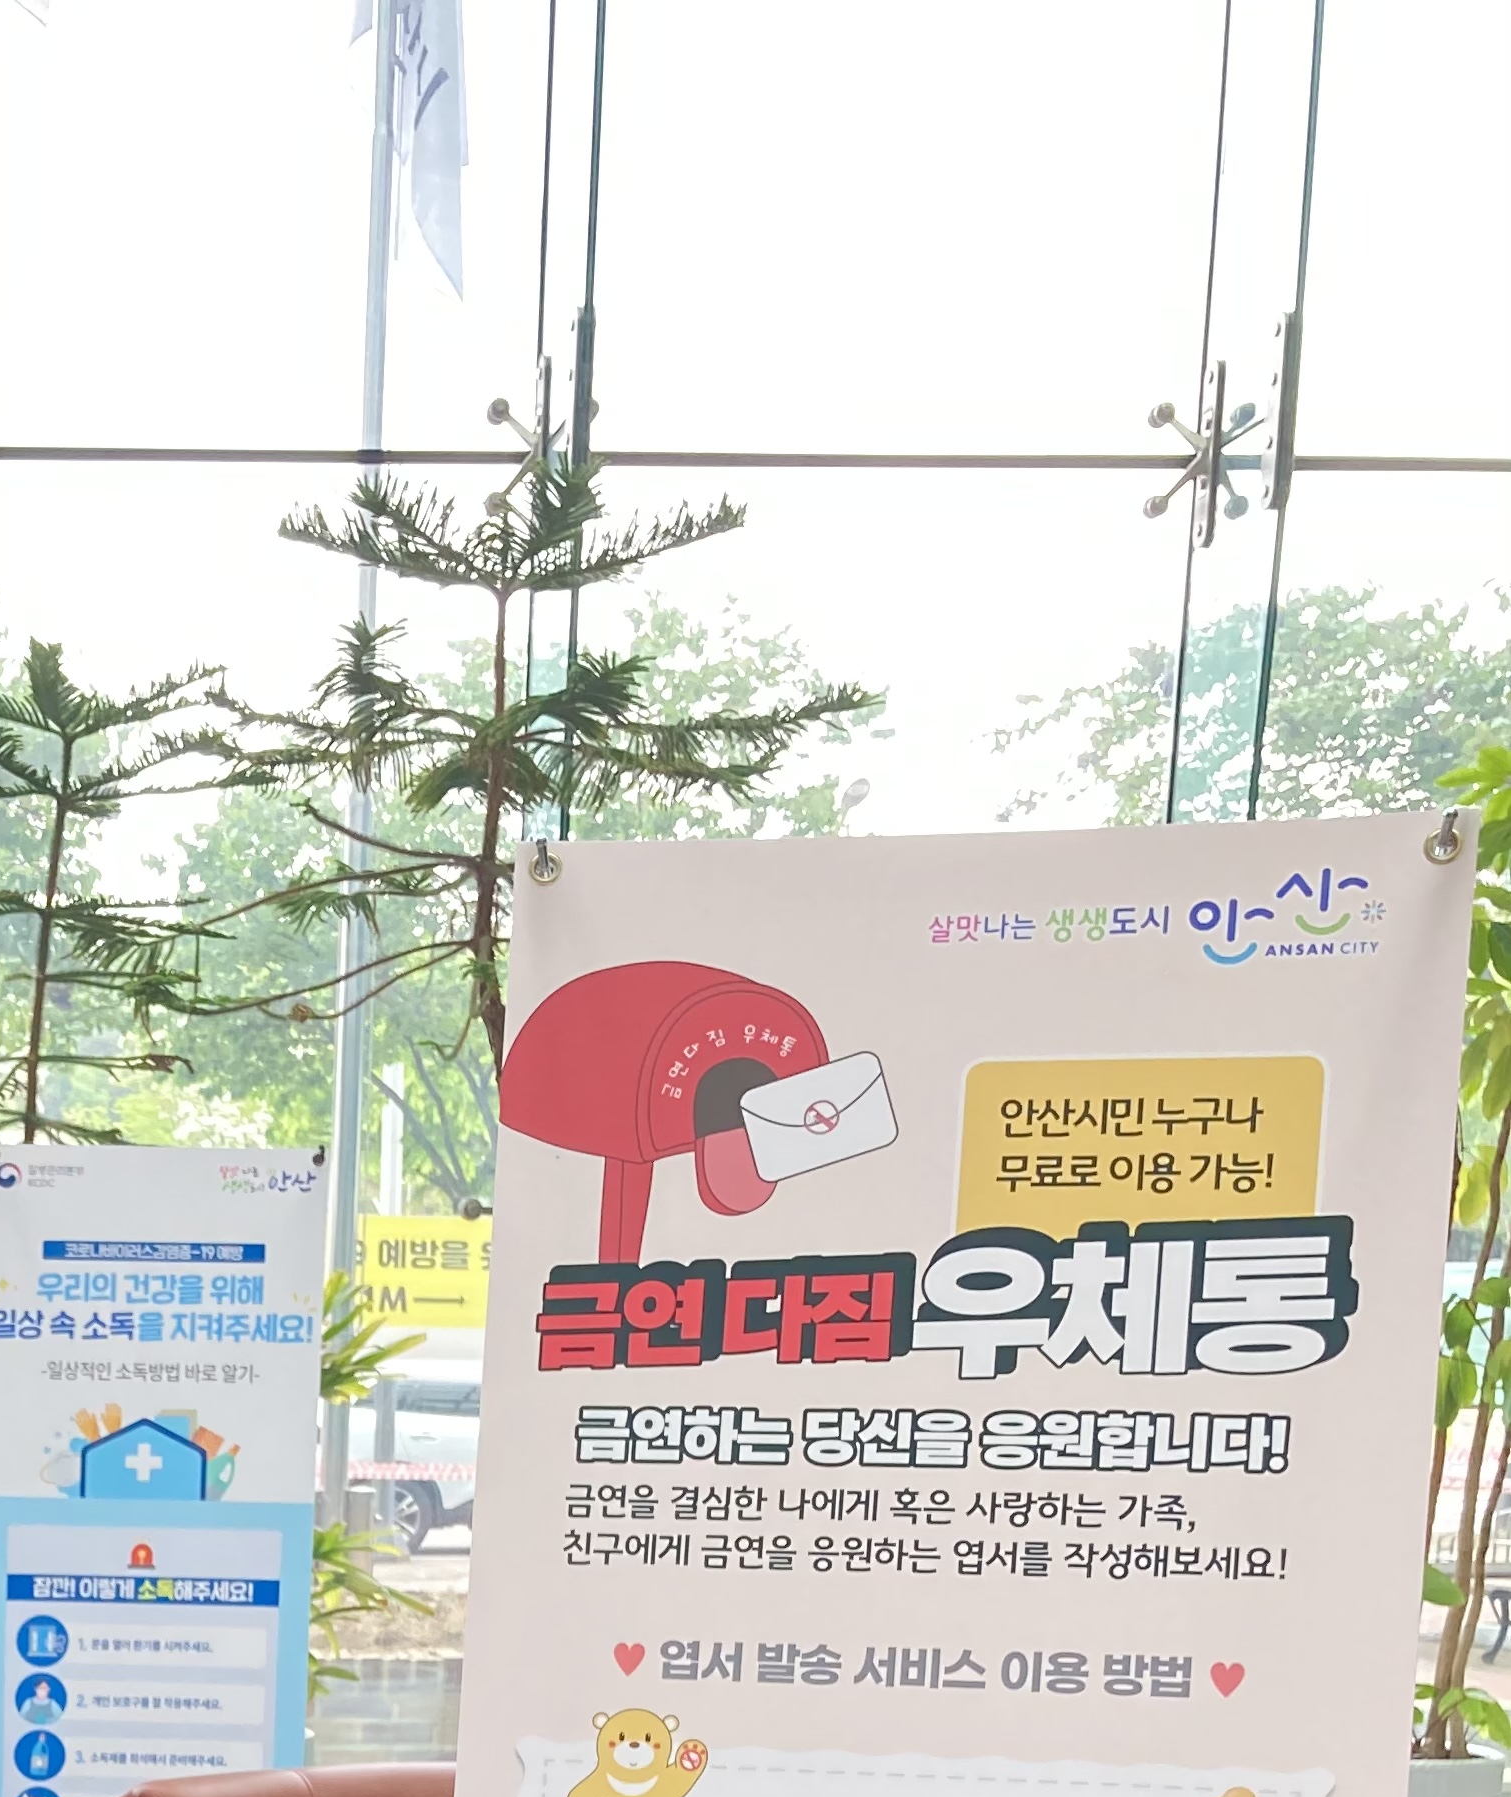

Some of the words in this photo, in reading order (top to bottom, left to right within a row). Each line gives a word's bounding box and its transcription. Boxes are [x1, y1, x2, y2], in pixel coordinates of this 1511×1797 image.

[928, 913, 1037, 944] 살맛나는
[1045, 905, 1170, 943] 생생도시
[1264, 942, 1335, 958] ANSAN
[1339, 940, 1379, 955] CITY
[1000, 1097, 1145, 1139] 안산시민
[1151, 1096, 1265, 1136] 누구나
[995, 1154, 1102, 1193] 무료로
[1109, 1151, 1182, 1195] 이용
[1189, 1152, 1275, 1194] 가능!
[377, 1238, 470, 1271] 예방을
[36, 1271, 117, 1303] 우리의
[124, 1273, 204, 1306] 건강을
[209, 1274, 264, 1306] 위해
[536, 1276, 707, 1371] 금연
[721, 1271, 895, 1364] 다짐
[911, 1235, 1336, 1380] 우체통
[49, 1309, 76, 1340] 속
[81, 1310, 164, 1342] 소독을
[171, 1312, 313, 1344] 지켜주세요!
[40, 1359, 112, 1382] -일상적인
[115, 1362, 181, 1384] 소독방법
[184, 1362, 218, 1383] 바로
[221, 1363, 261, 1385] 알기-
[575, 1405, 793, 1465] 금연하는
[802, 1407, 971, 1468] 당신을
[979, 1409, 1291, 1473] 응원합니다!
[565, 1483, 659, 1520] 금연을
[670, 1485, 768, 1522] 결심한
[778, 1487, 879, 1522] 나에게
[889, 1487, 956, 1526] 혹은
[965, 1491, 1107, 1529] 사랑하는
[1118, 1493, 1196, 1534] 가족,
[563, 1529, 691, 1567] 친구에게
[701, 1533, 797, 1572] 금연을
[807, 1535, 942, 1575] 응원하는
[953, 1539, 1053, 1578] 엽서를
[1064, 1542, 1288, 1581] 작성해보세요!
[33, 1576, 76, 1599] 잠깐!
[79, 1577, 135, 1600] 이렇게
[137, 1579, 254, 1603] 소독해주세요!
[659, 1639, 744, 1683] 엽서
[756, 1642, 843, 1686] 발송
[853, 1646, 987, 1690] 서비스
[1000, 1650, 1090, 1695] 이용
[1103, 1653, 1193, 1699] 방법
